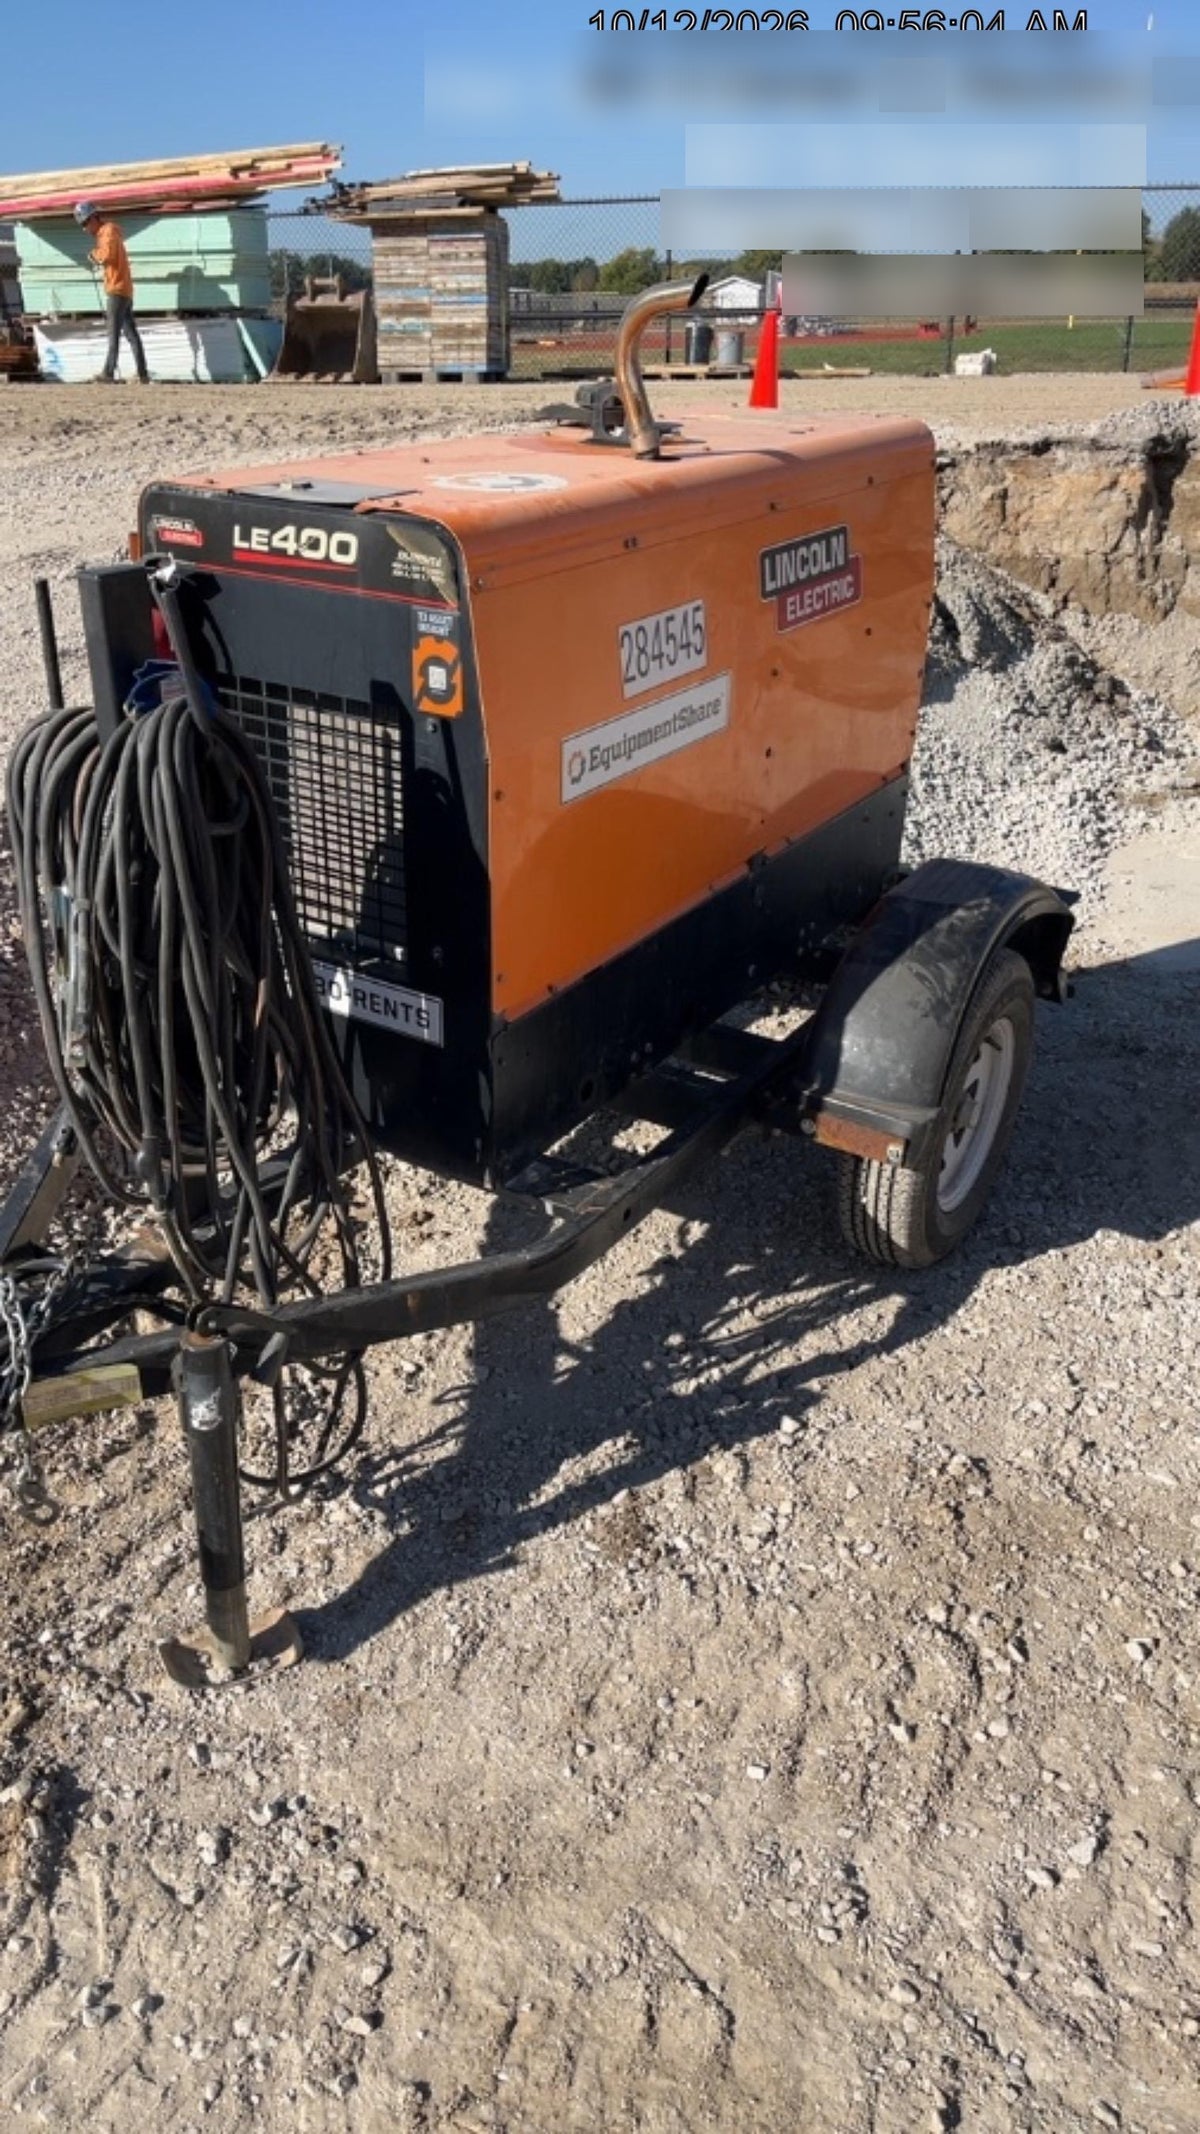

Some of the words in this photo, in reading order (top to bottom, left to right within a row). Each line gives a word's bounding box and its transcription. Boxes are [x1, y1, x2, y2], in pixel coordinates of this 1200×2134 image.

[233, 524, 358, 565] LE400
[764, 533, 845, 592] LINCOLN
[786, 575, 855, 622] ELECTRIC
[621, 604, 705, 683] 284545
[588, 697, 722, 772] EquipmentShare
